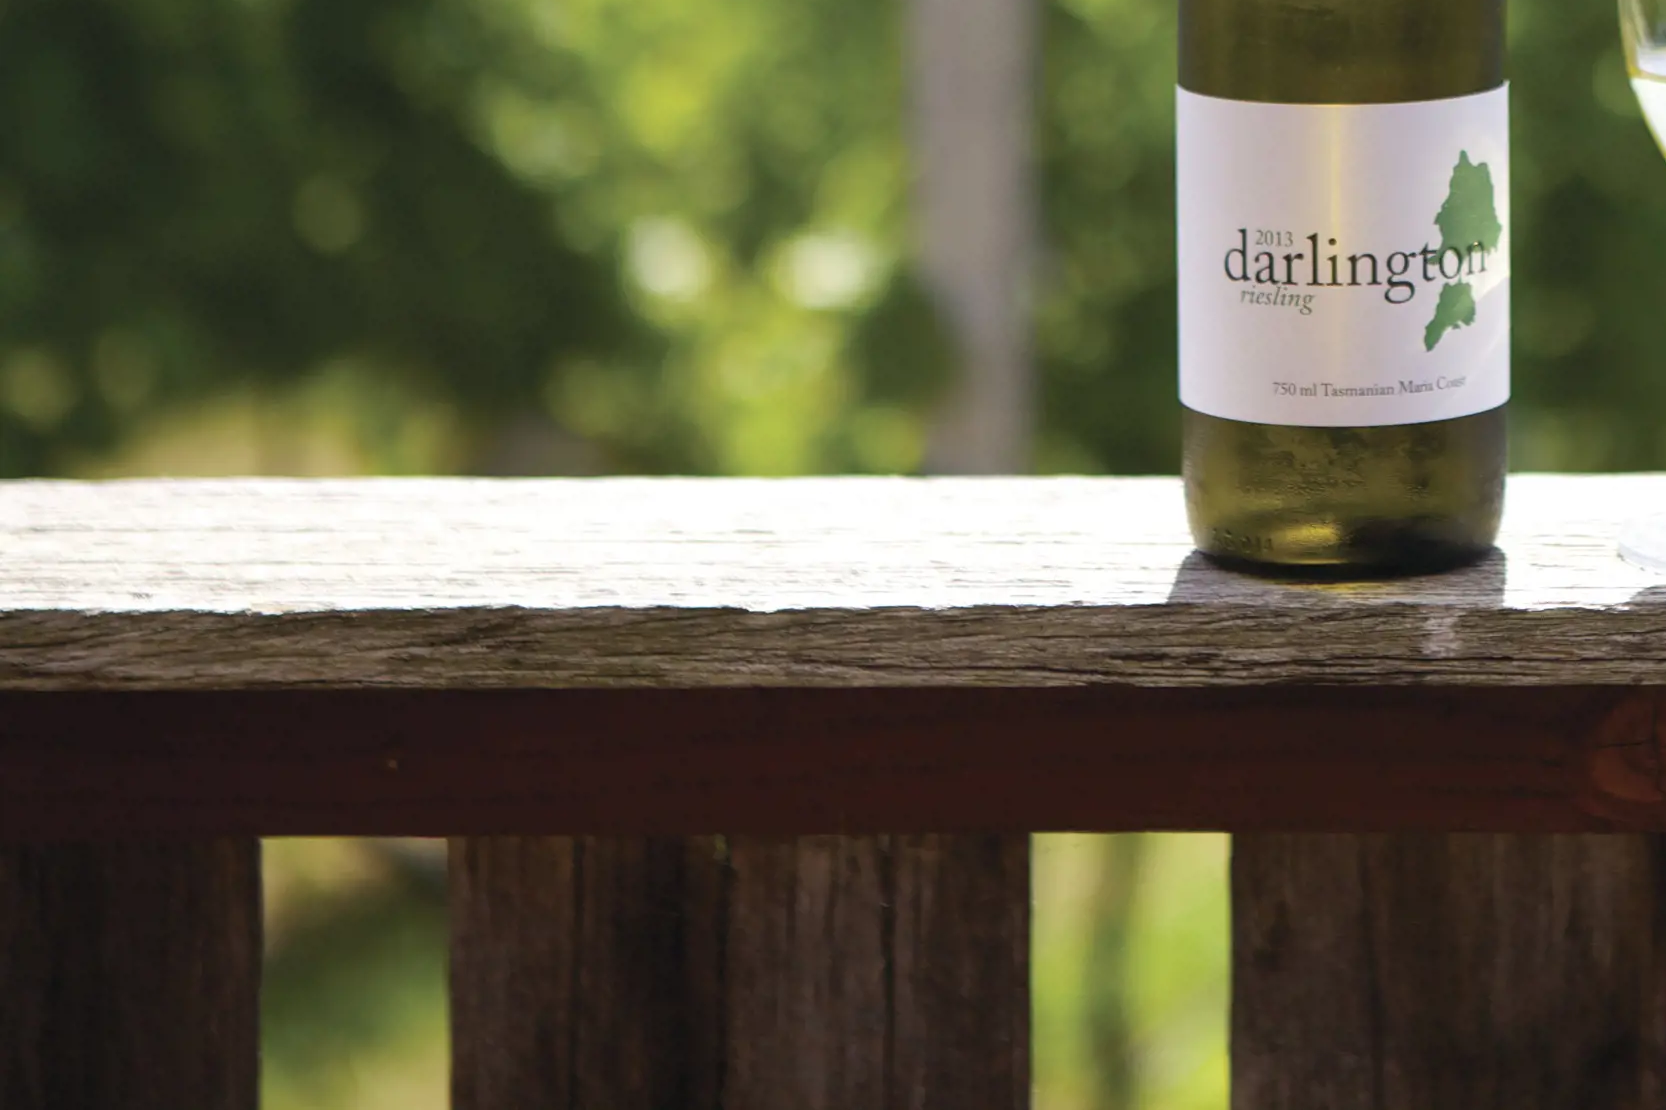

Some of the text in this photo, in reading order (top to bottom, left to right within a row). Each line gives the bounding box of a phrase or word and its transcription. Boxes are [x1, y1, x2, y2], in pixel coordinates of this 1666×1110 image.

[1255, 229, 1293, 247] 2013
[1224, 228, 1488, 304] darlington
[1240, 285, 1315, 315] riesling
[1272, 381, 1297, 397] 750
[1300, 382, 1317, 397] ml
[1320, 382, 1394, 397] Tasmanian
